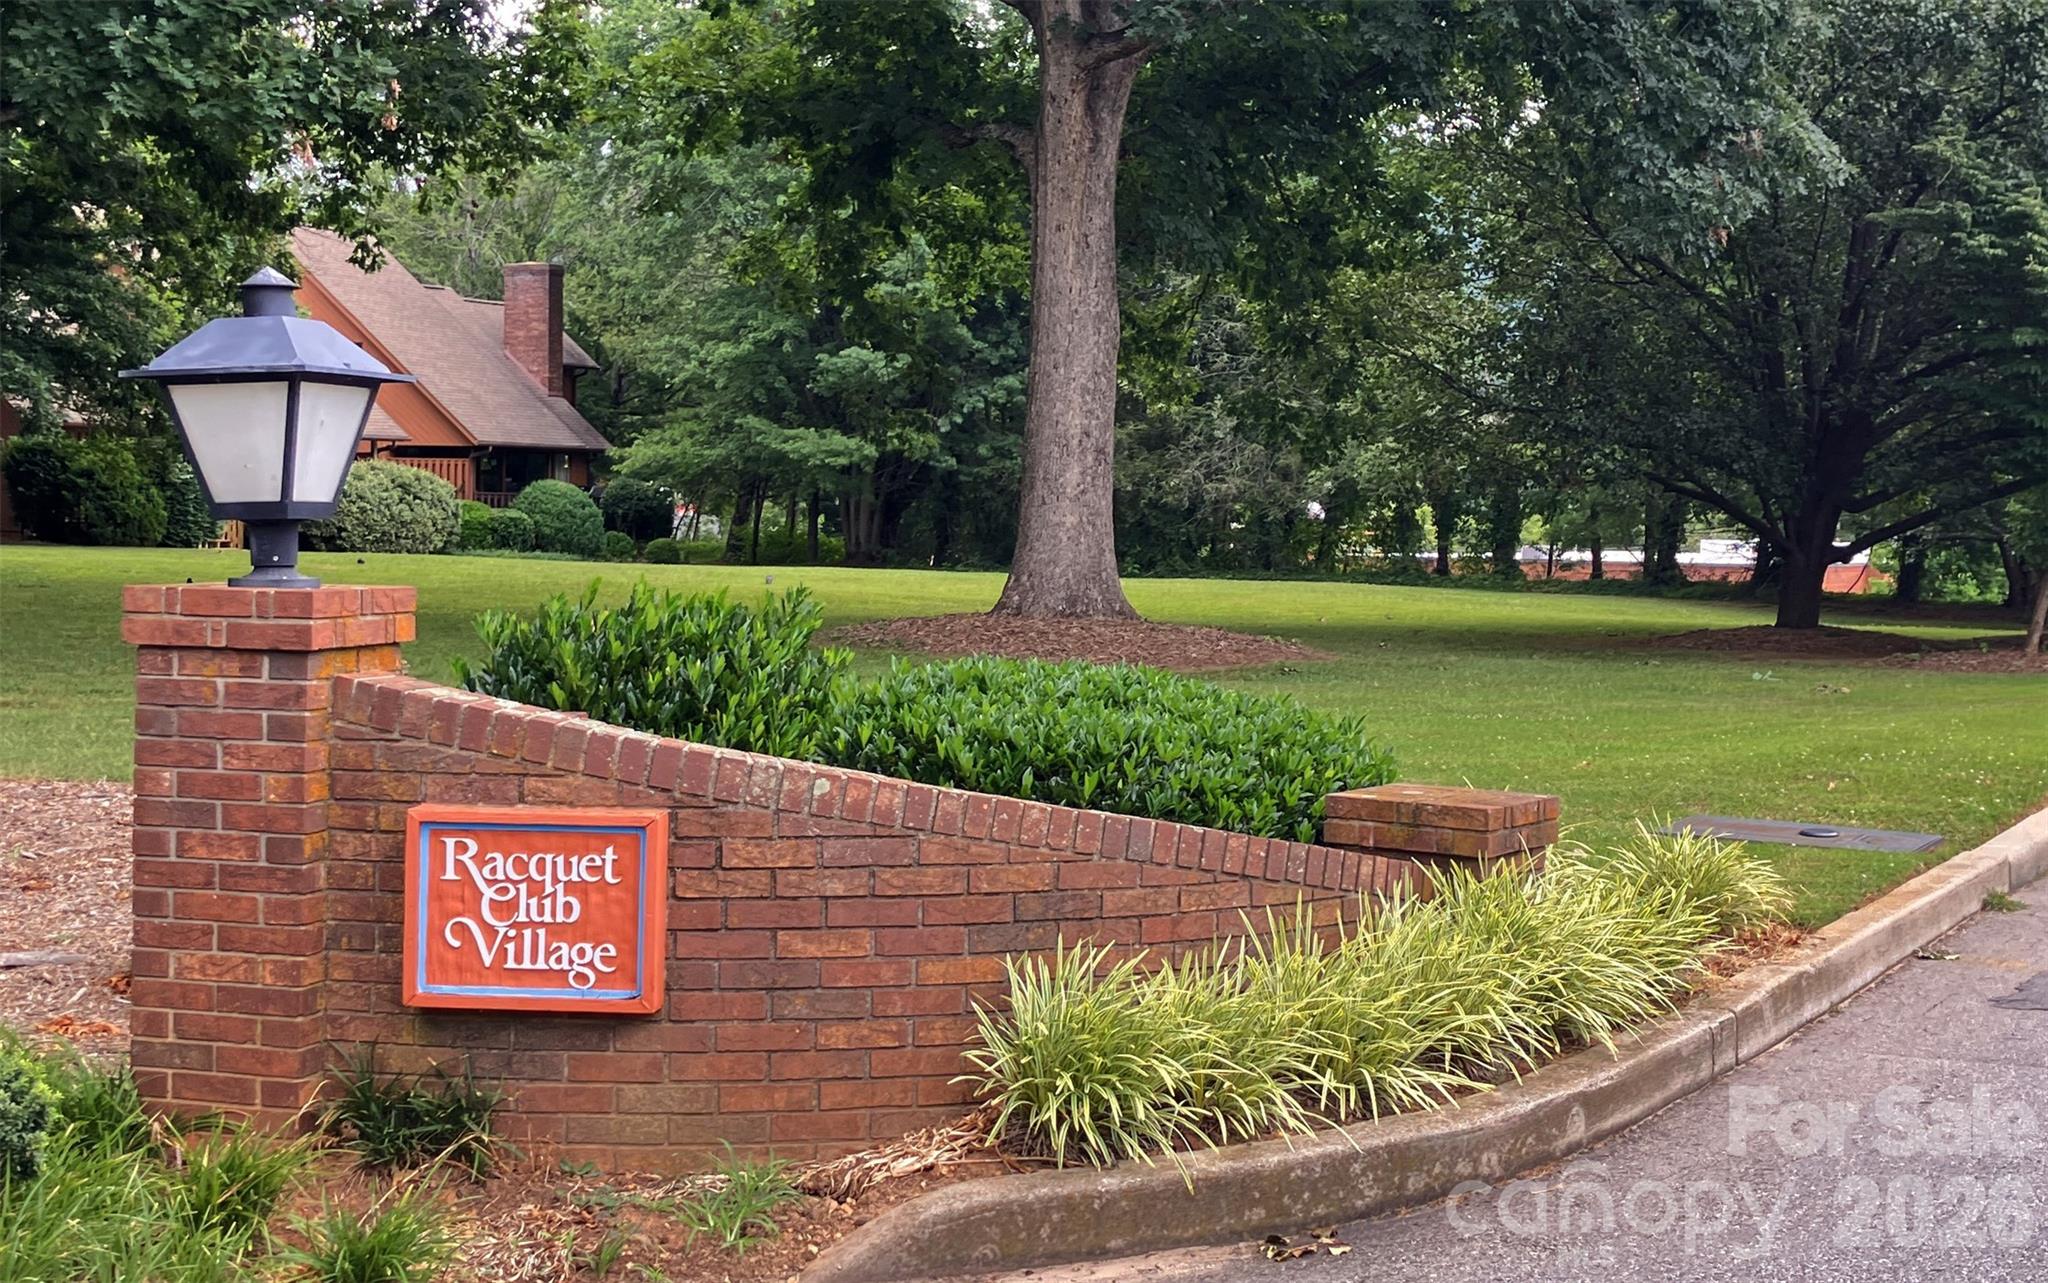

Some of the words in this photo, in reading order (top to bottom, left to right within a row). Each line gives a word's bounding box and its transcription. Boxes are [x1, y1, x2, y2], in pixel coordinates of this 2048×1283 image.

[440, 837, 622, 895] Racquet
[480, 882, 581, 927] Club
[444, 917, 618, 989] Village
